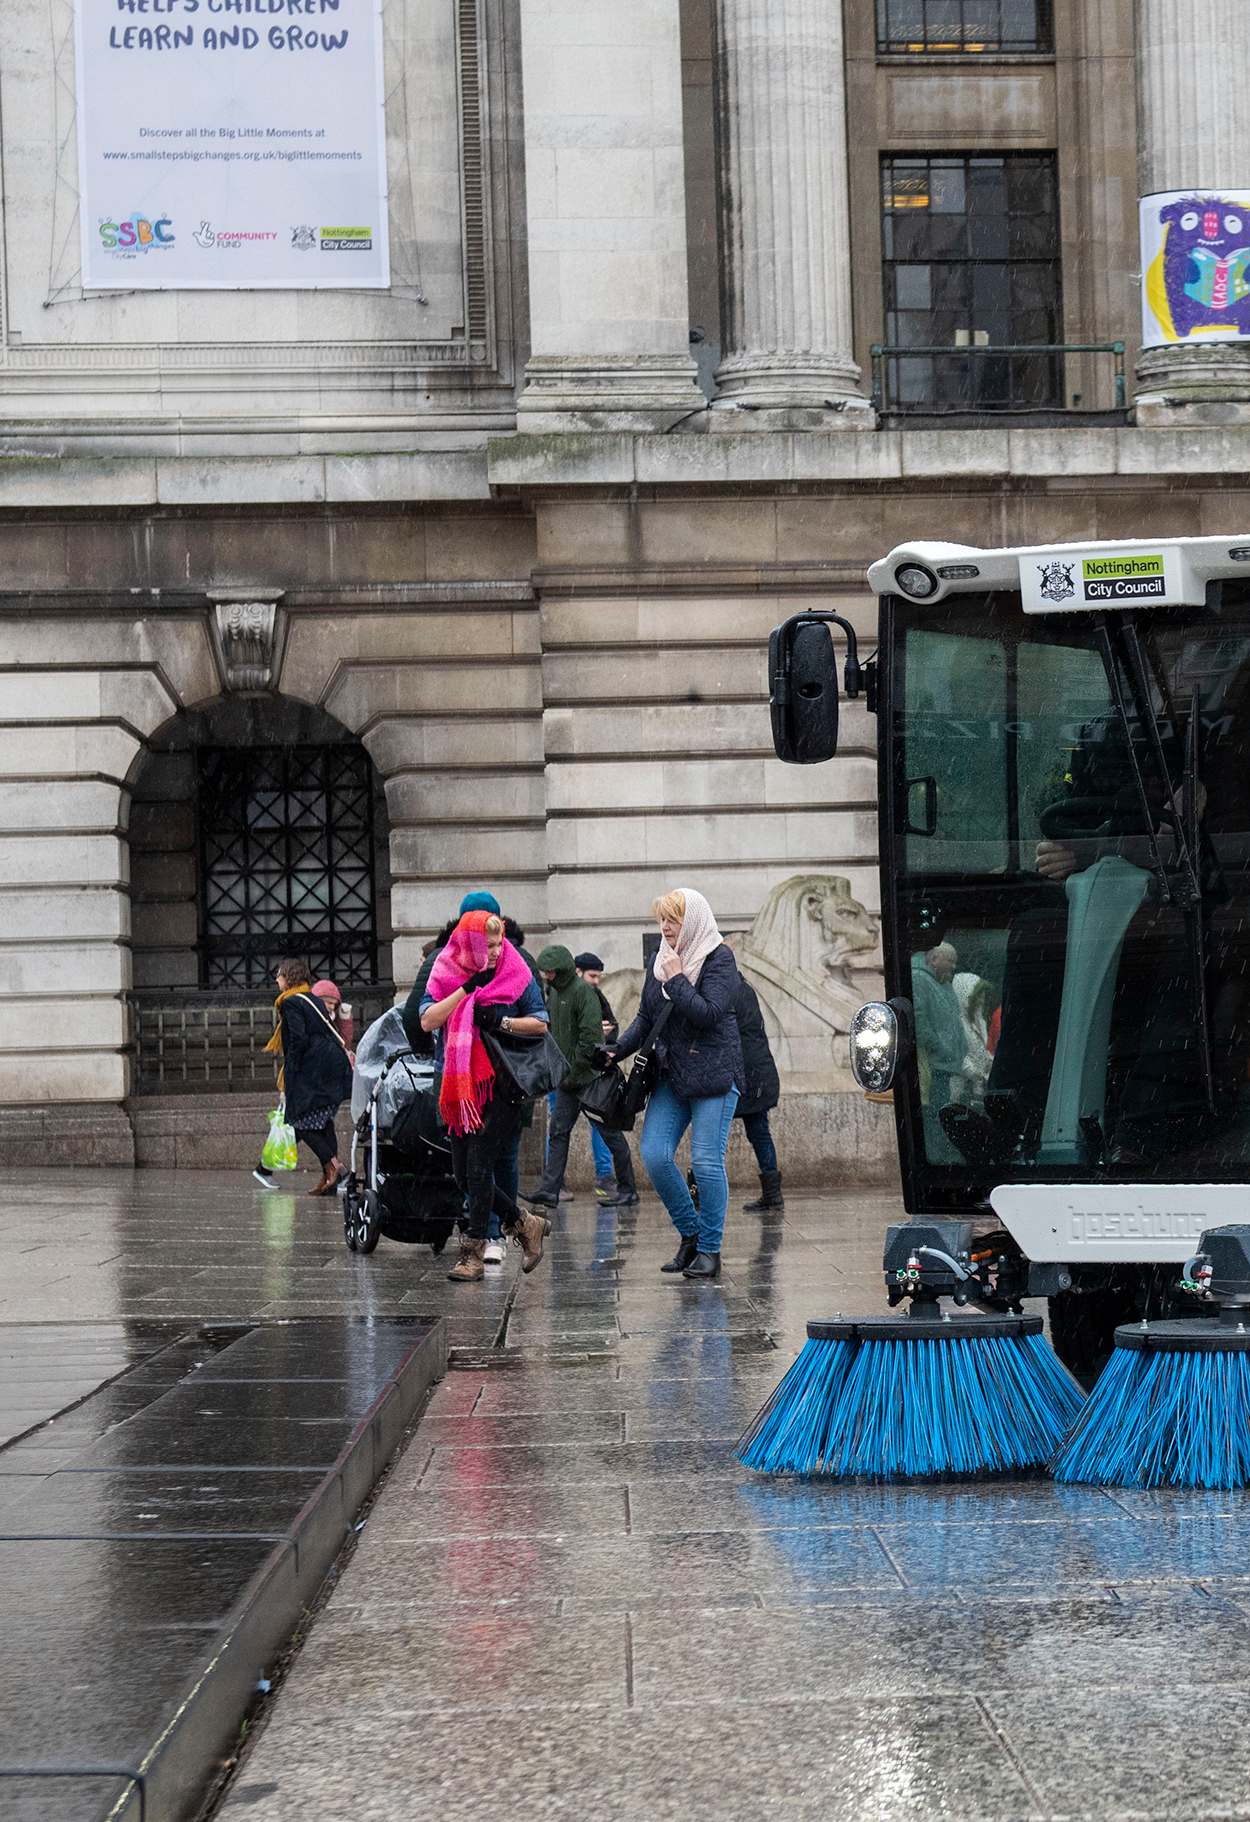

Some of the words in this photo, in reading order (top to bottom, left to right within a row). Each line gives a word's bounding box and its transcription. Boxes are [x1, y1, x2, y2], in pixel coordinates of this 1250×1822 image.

[109, 25, 194, 51] LEARN
[203, 25, 259, 50] AND
[268, 25, 349, 52] GROW
[139, 128, 183, 138] Discover
[185, 128, 197, 138] all
[199, 128, 216, 138] the
[218, 128, 236, 141] Big
[238, 128, 263, 138] Little
[266, 128, 312, 138] Moments
[314, 128, 325, 138] at
[103, 150, 362, 162] www.smallstepsbigchanges.org.uk/biglittlemoments
[99, 219, 175, 248] SSBC
[216, 232, 278, 241] COMMUNITY
[321, 228, 370, 239] Nottingham
[217, 241, 241, 249] FUND
[322, 240, 339, 250] City
[340, 240, 371, 249] Council
[1086, 560, 1159, 576] Nottingham
[1087, 582, 1112, 598] City
[1115, 579, 1162, 595] Council
